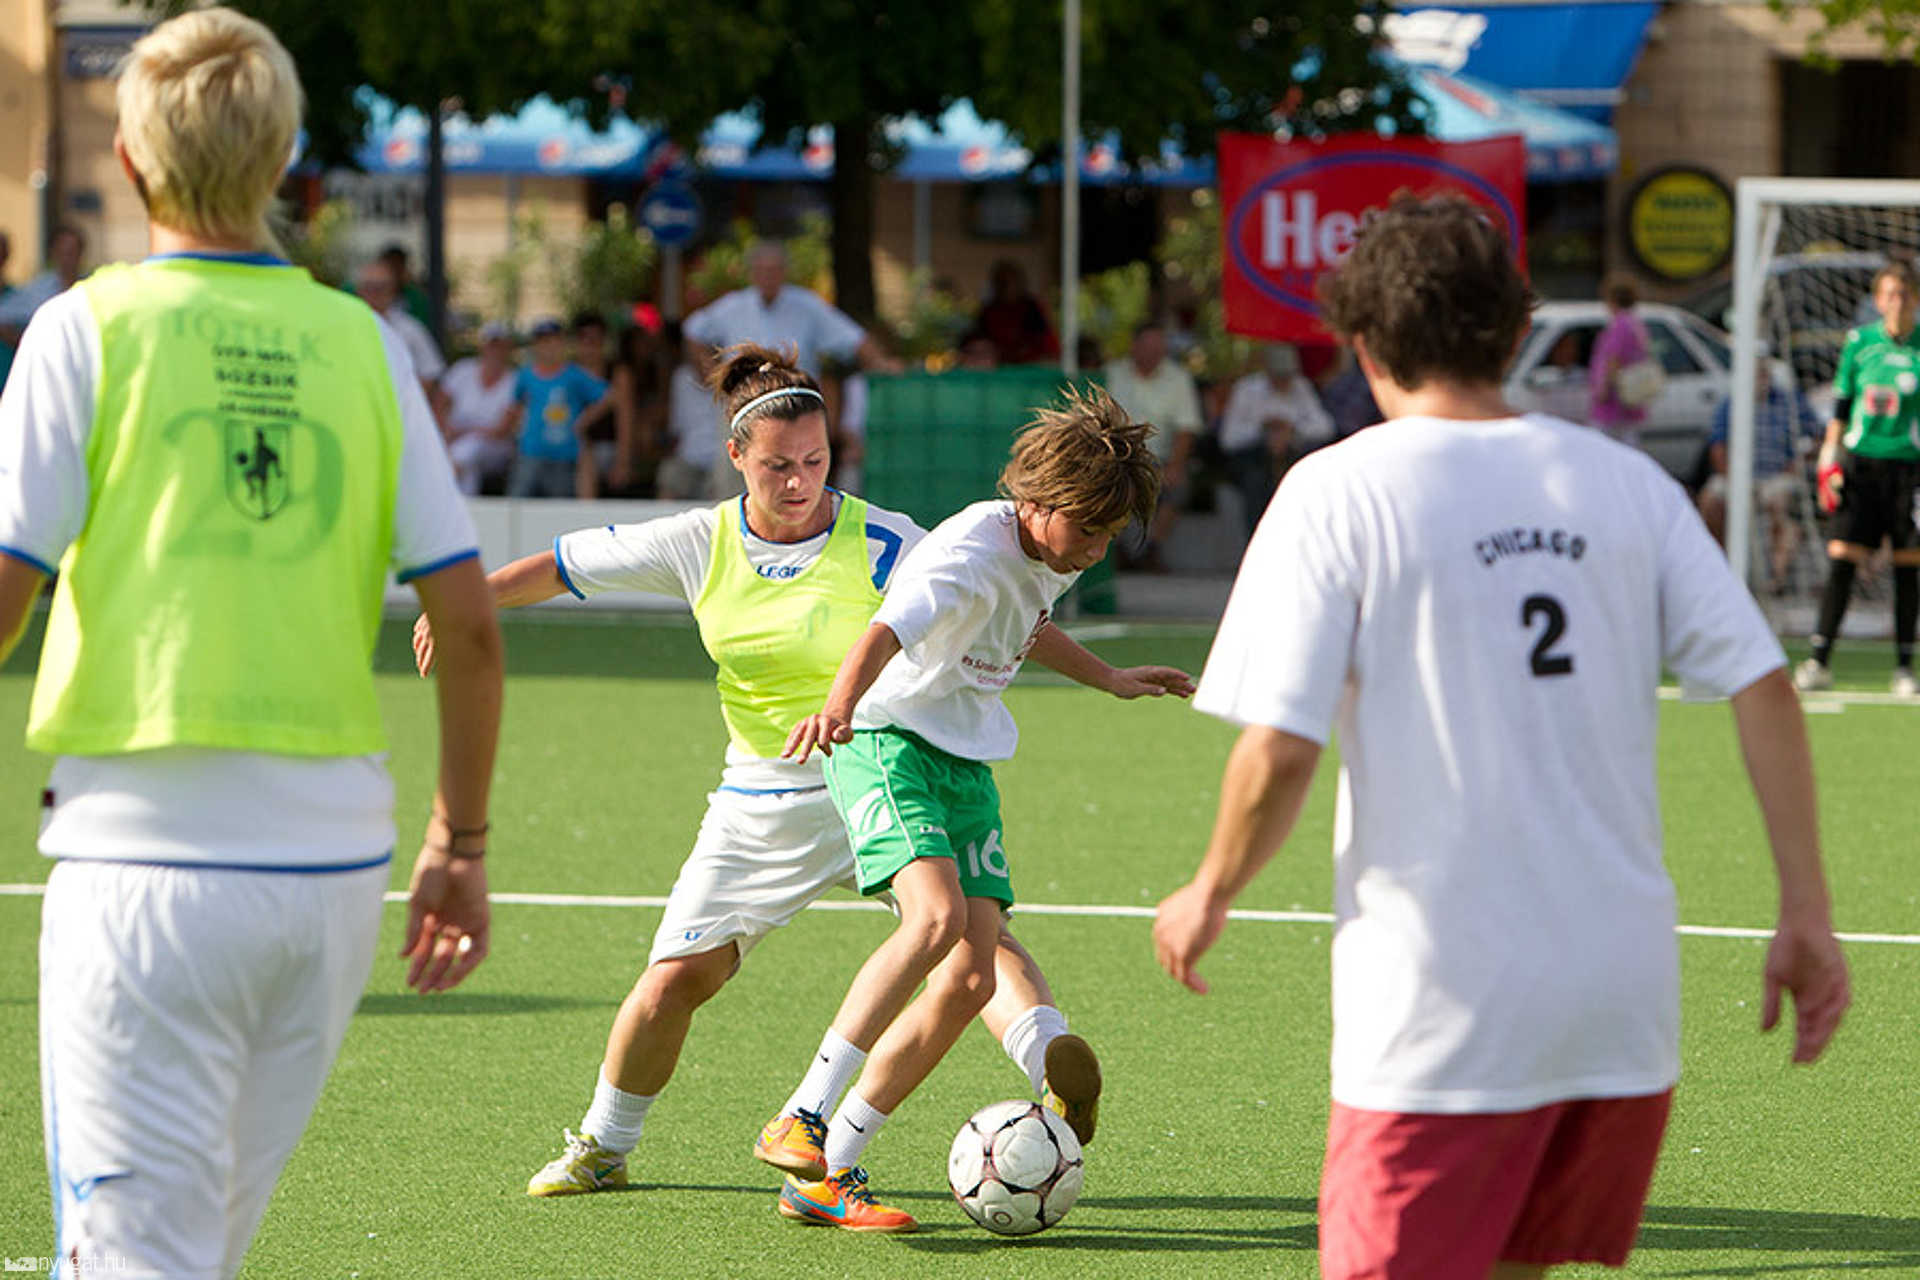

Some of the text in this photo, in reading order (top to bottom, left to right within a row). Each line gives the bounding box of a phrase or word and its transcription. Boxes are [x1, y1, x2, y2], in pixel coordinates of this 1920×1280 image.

[1261, 190, 1366, 269] He
[1475, 528, 1587, 567] CHICAGO
[1521, 594, 1575, 678] 2
[967, 829, 1008, 877] 16
